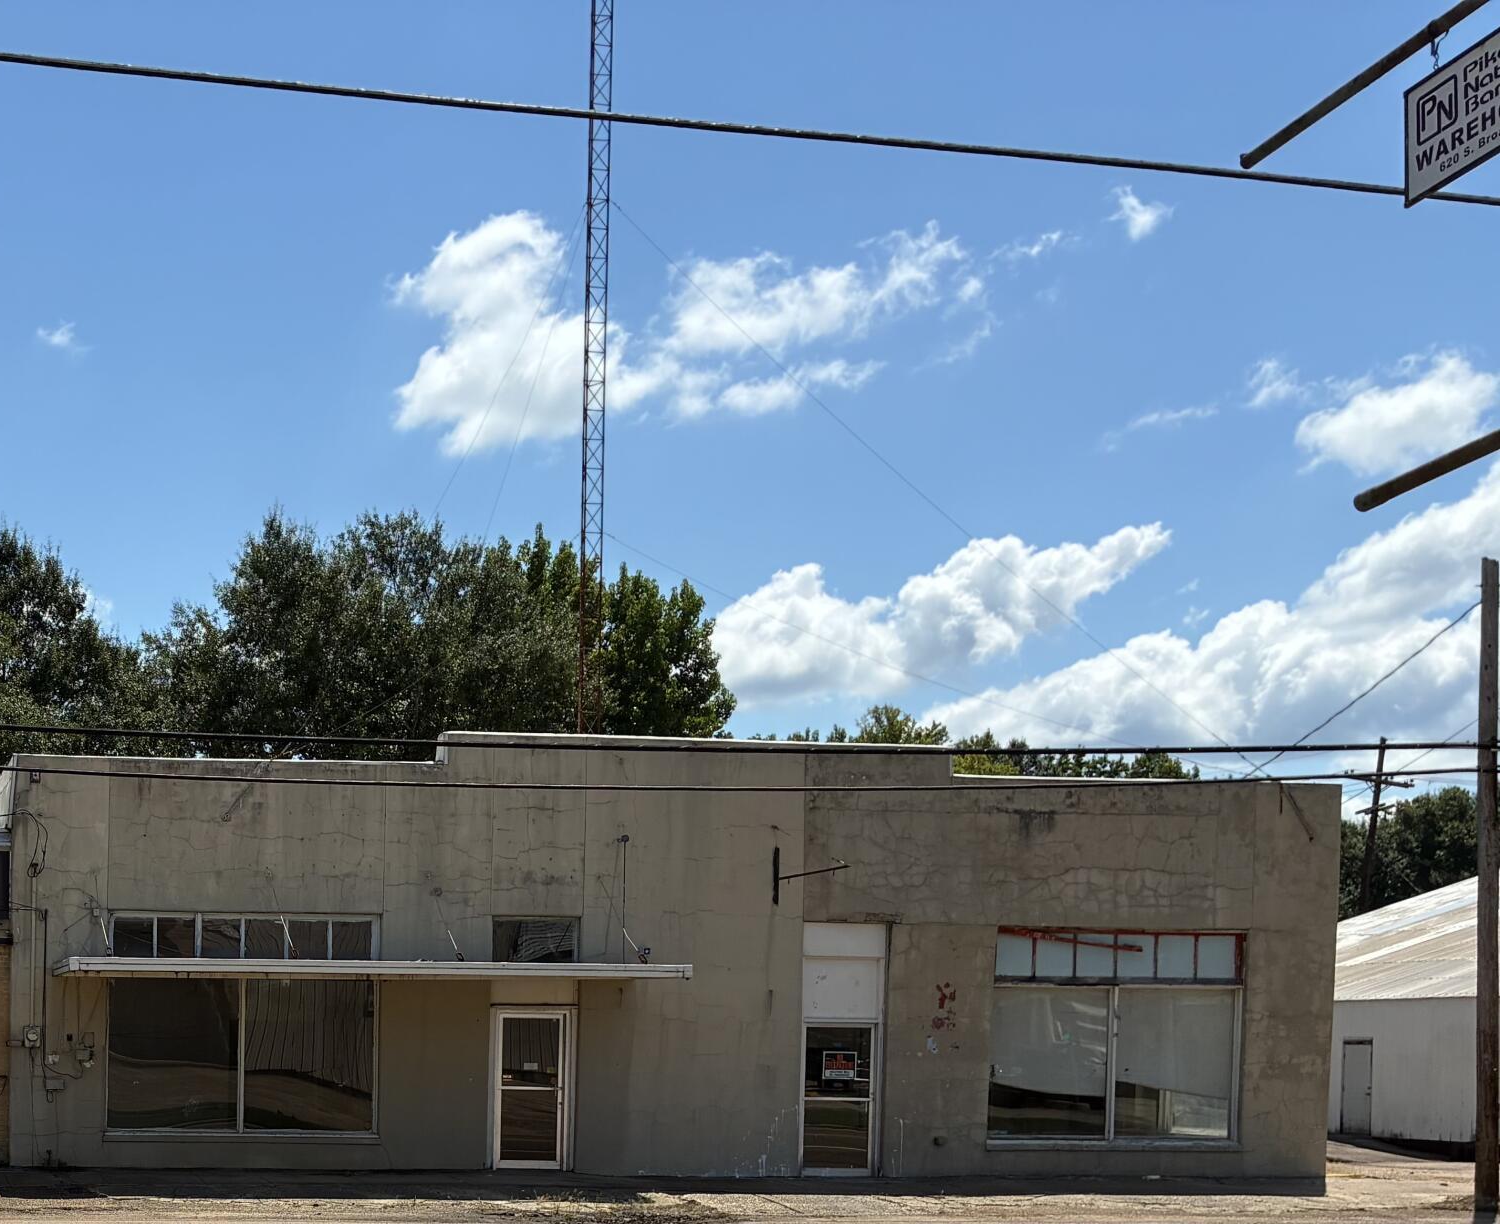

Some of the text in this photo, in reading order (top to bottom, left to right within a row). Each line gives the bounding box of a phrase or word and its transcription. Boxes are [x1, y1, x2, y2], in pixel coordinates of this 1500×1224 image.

[1415, 105, 1500, 171] WAREH
[1439, 130, 1500, 172] 620 S. Bro
